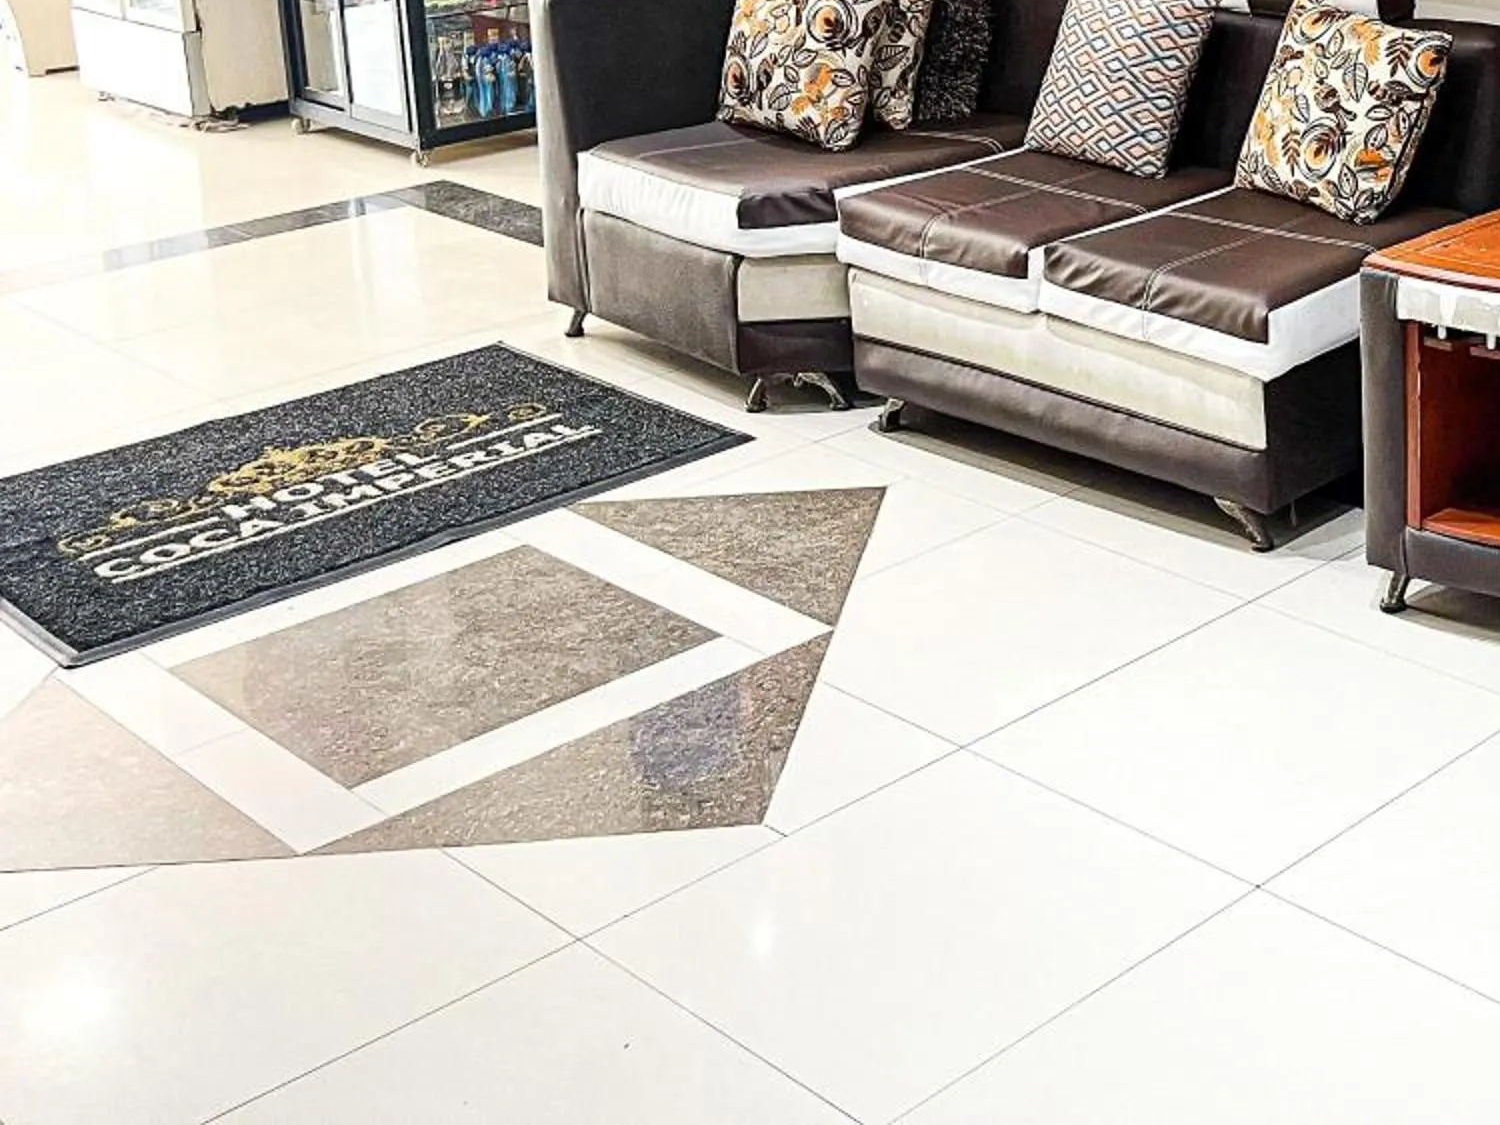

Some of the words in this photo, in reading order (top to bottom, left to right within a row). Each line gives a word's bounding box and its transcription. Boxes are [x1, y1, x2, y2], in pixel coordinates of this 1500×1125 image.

[93, 520, 285, 578] COCA
[289, 423, 596, 517] IMPERIAL
[222, 452, 439, 520] HOTEL
